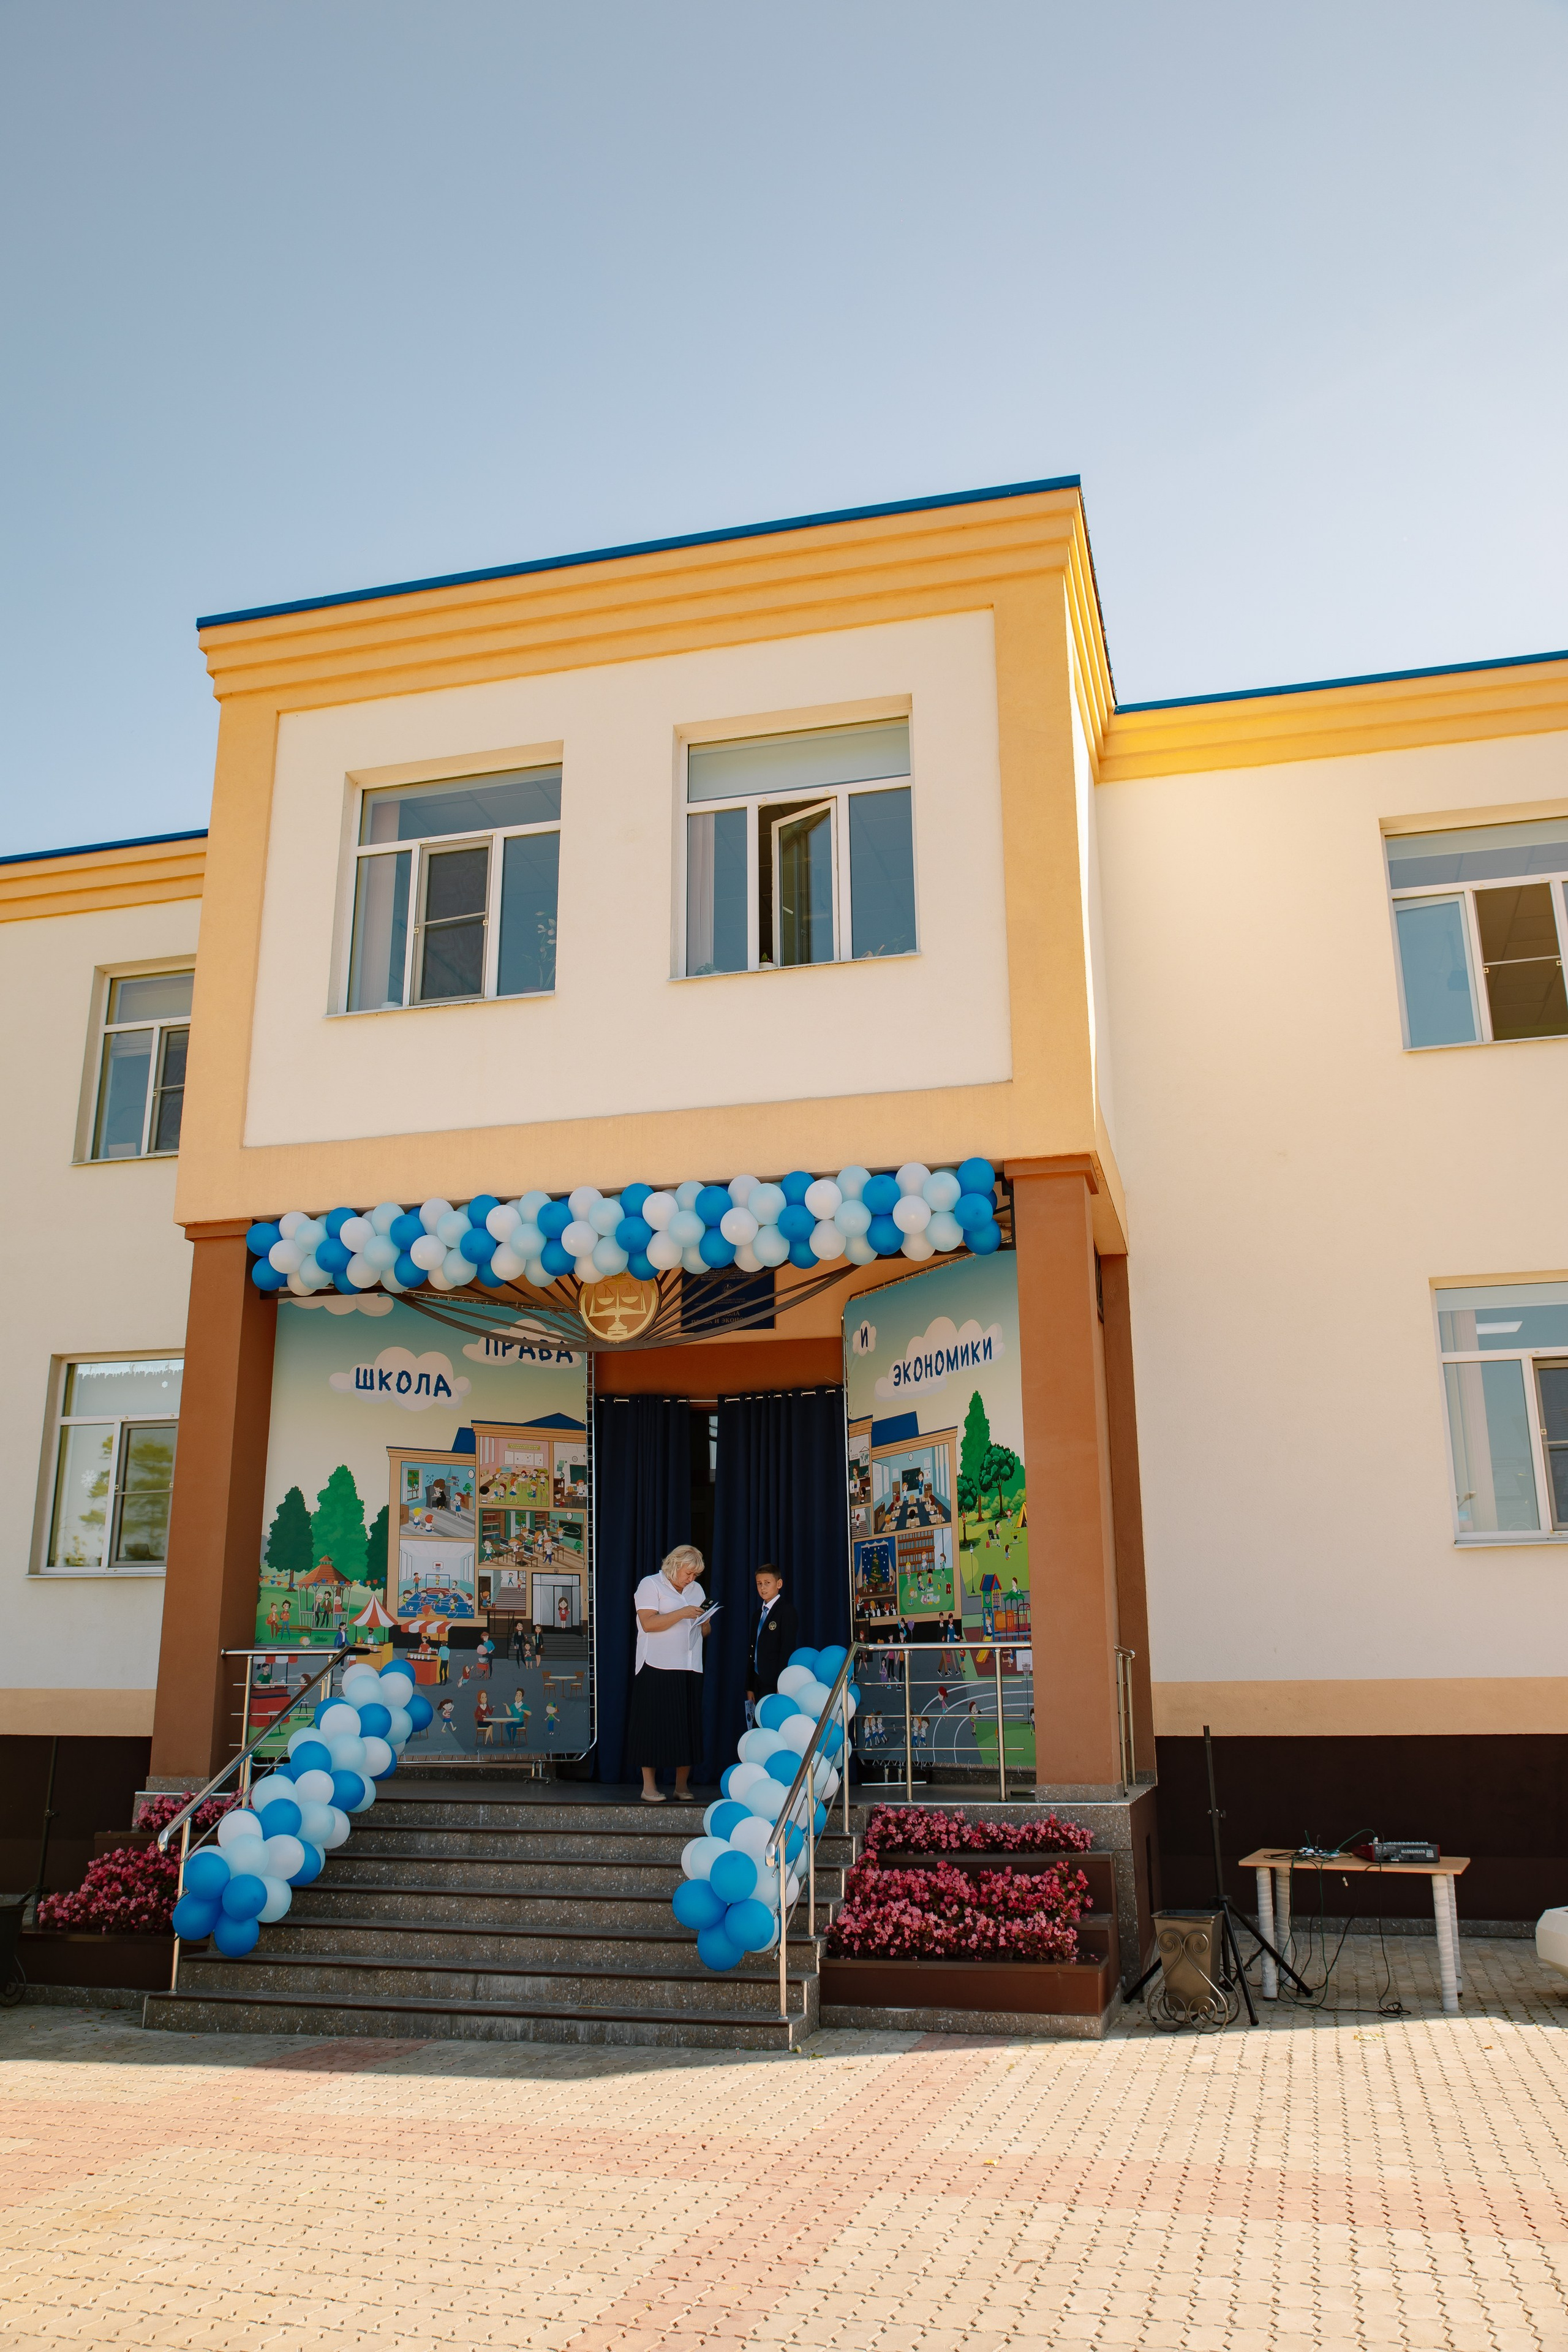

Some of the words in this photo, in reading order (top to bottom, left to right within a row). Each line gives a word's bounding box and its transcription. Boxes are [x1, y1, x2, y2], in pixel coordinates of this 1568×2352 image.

[861, 1327, 868, 1349] И
[893, 1336, 992, 1387] ЭКОНОМИКИ
[355, 1367, 452, 1398] ШКОЛА
